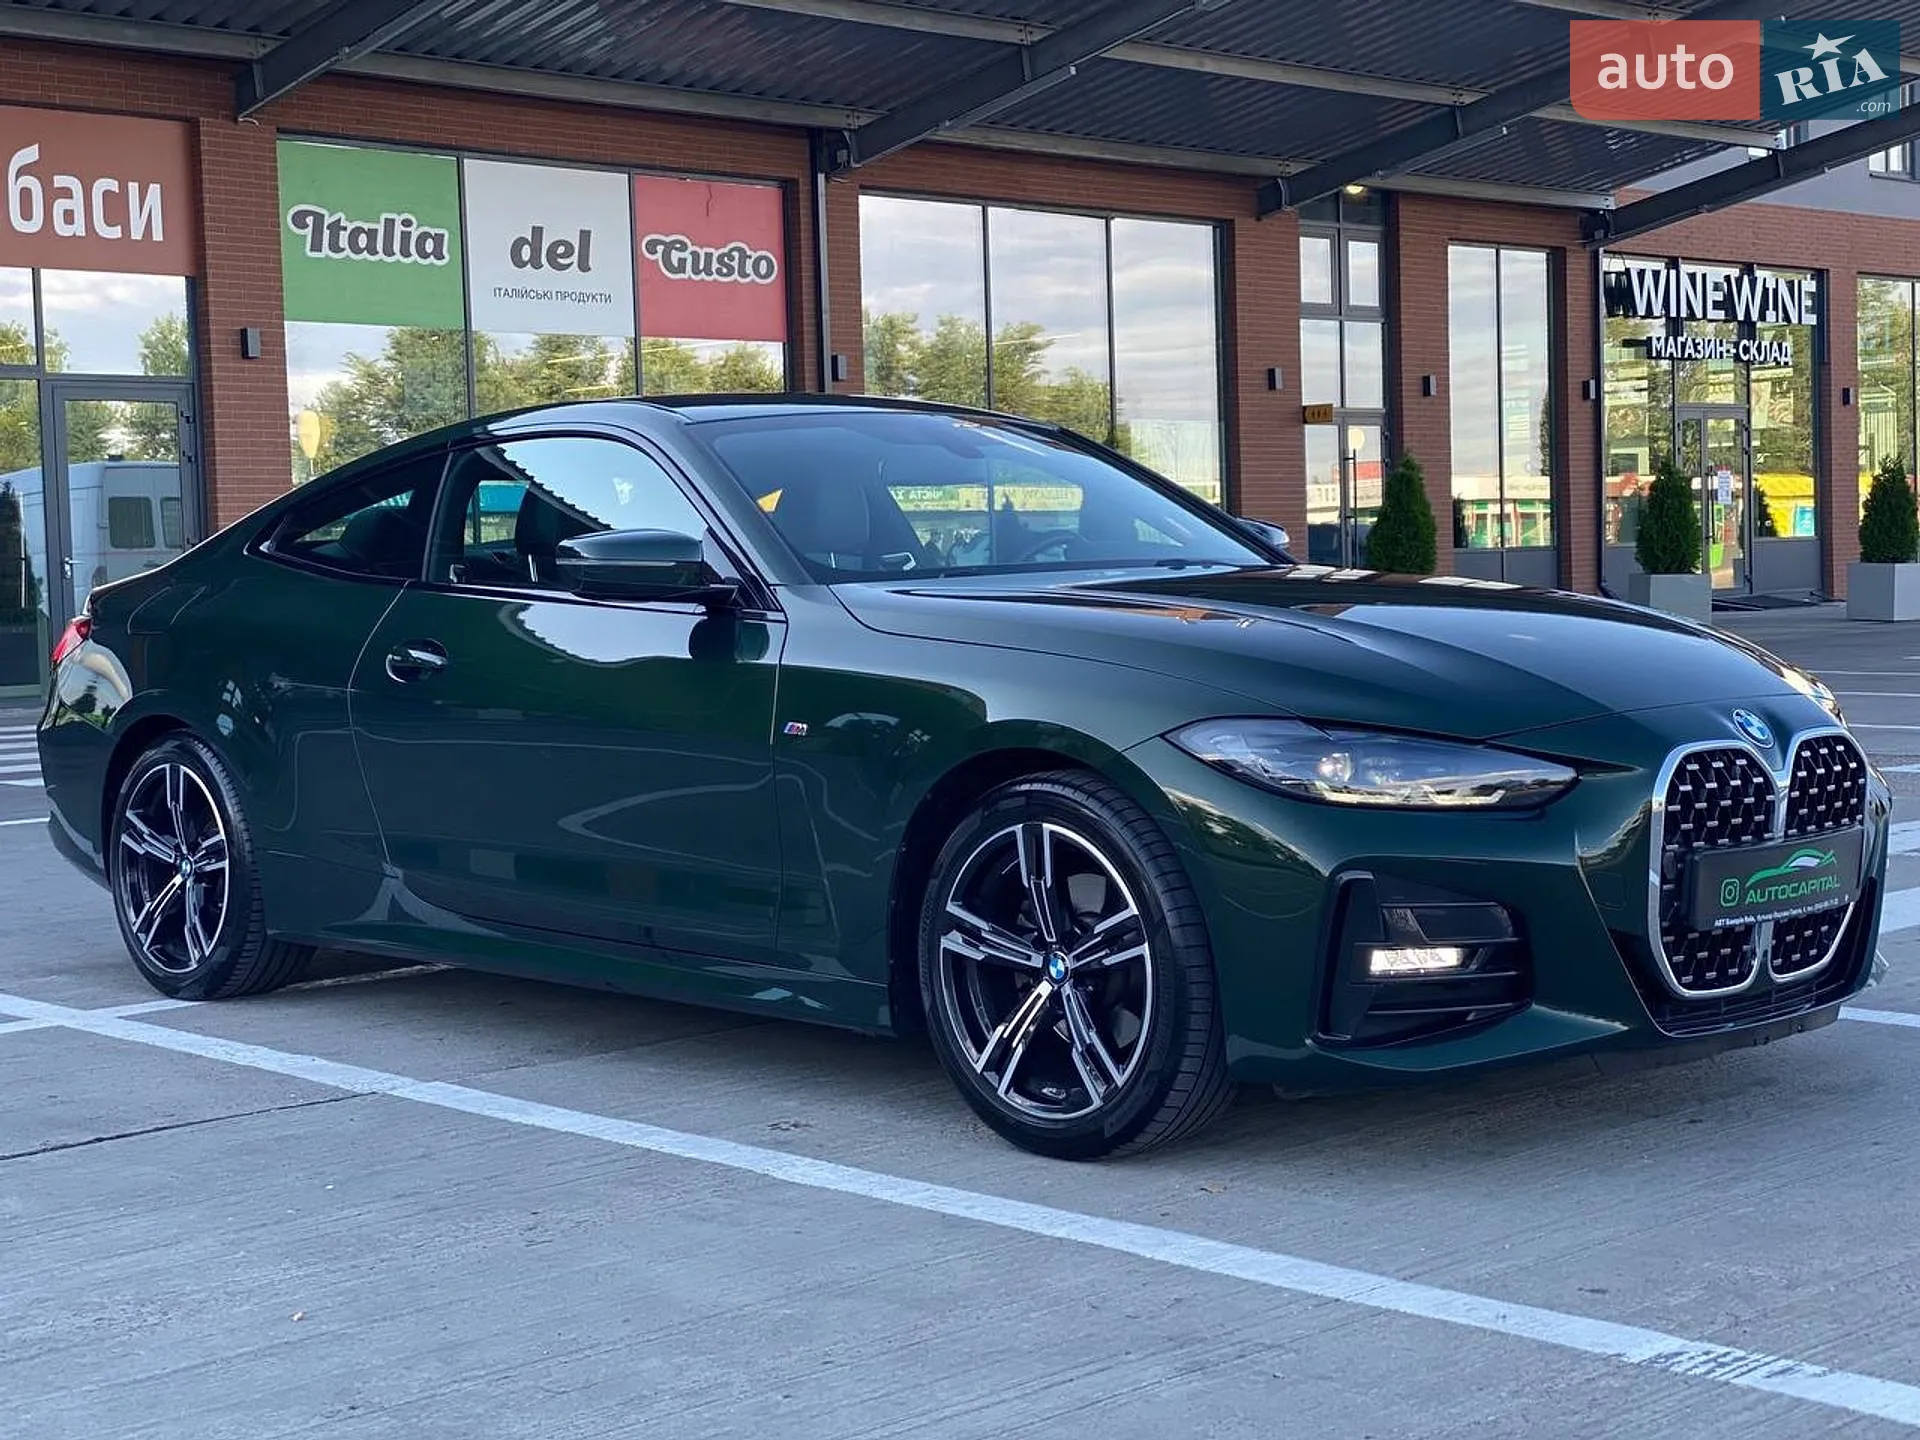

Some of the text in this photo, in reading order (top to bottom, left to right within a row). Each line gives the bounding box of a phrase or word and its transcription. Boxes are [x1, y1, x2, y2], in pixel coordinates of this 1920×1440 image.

[291, 209, 776, 281] Italia del Gusto
[493, 287, 612, 305] ІТАЛІЙСЬКІ ПРОДУКТИ
[1745, 876, 1841, 904] AUTOCAPITAL
